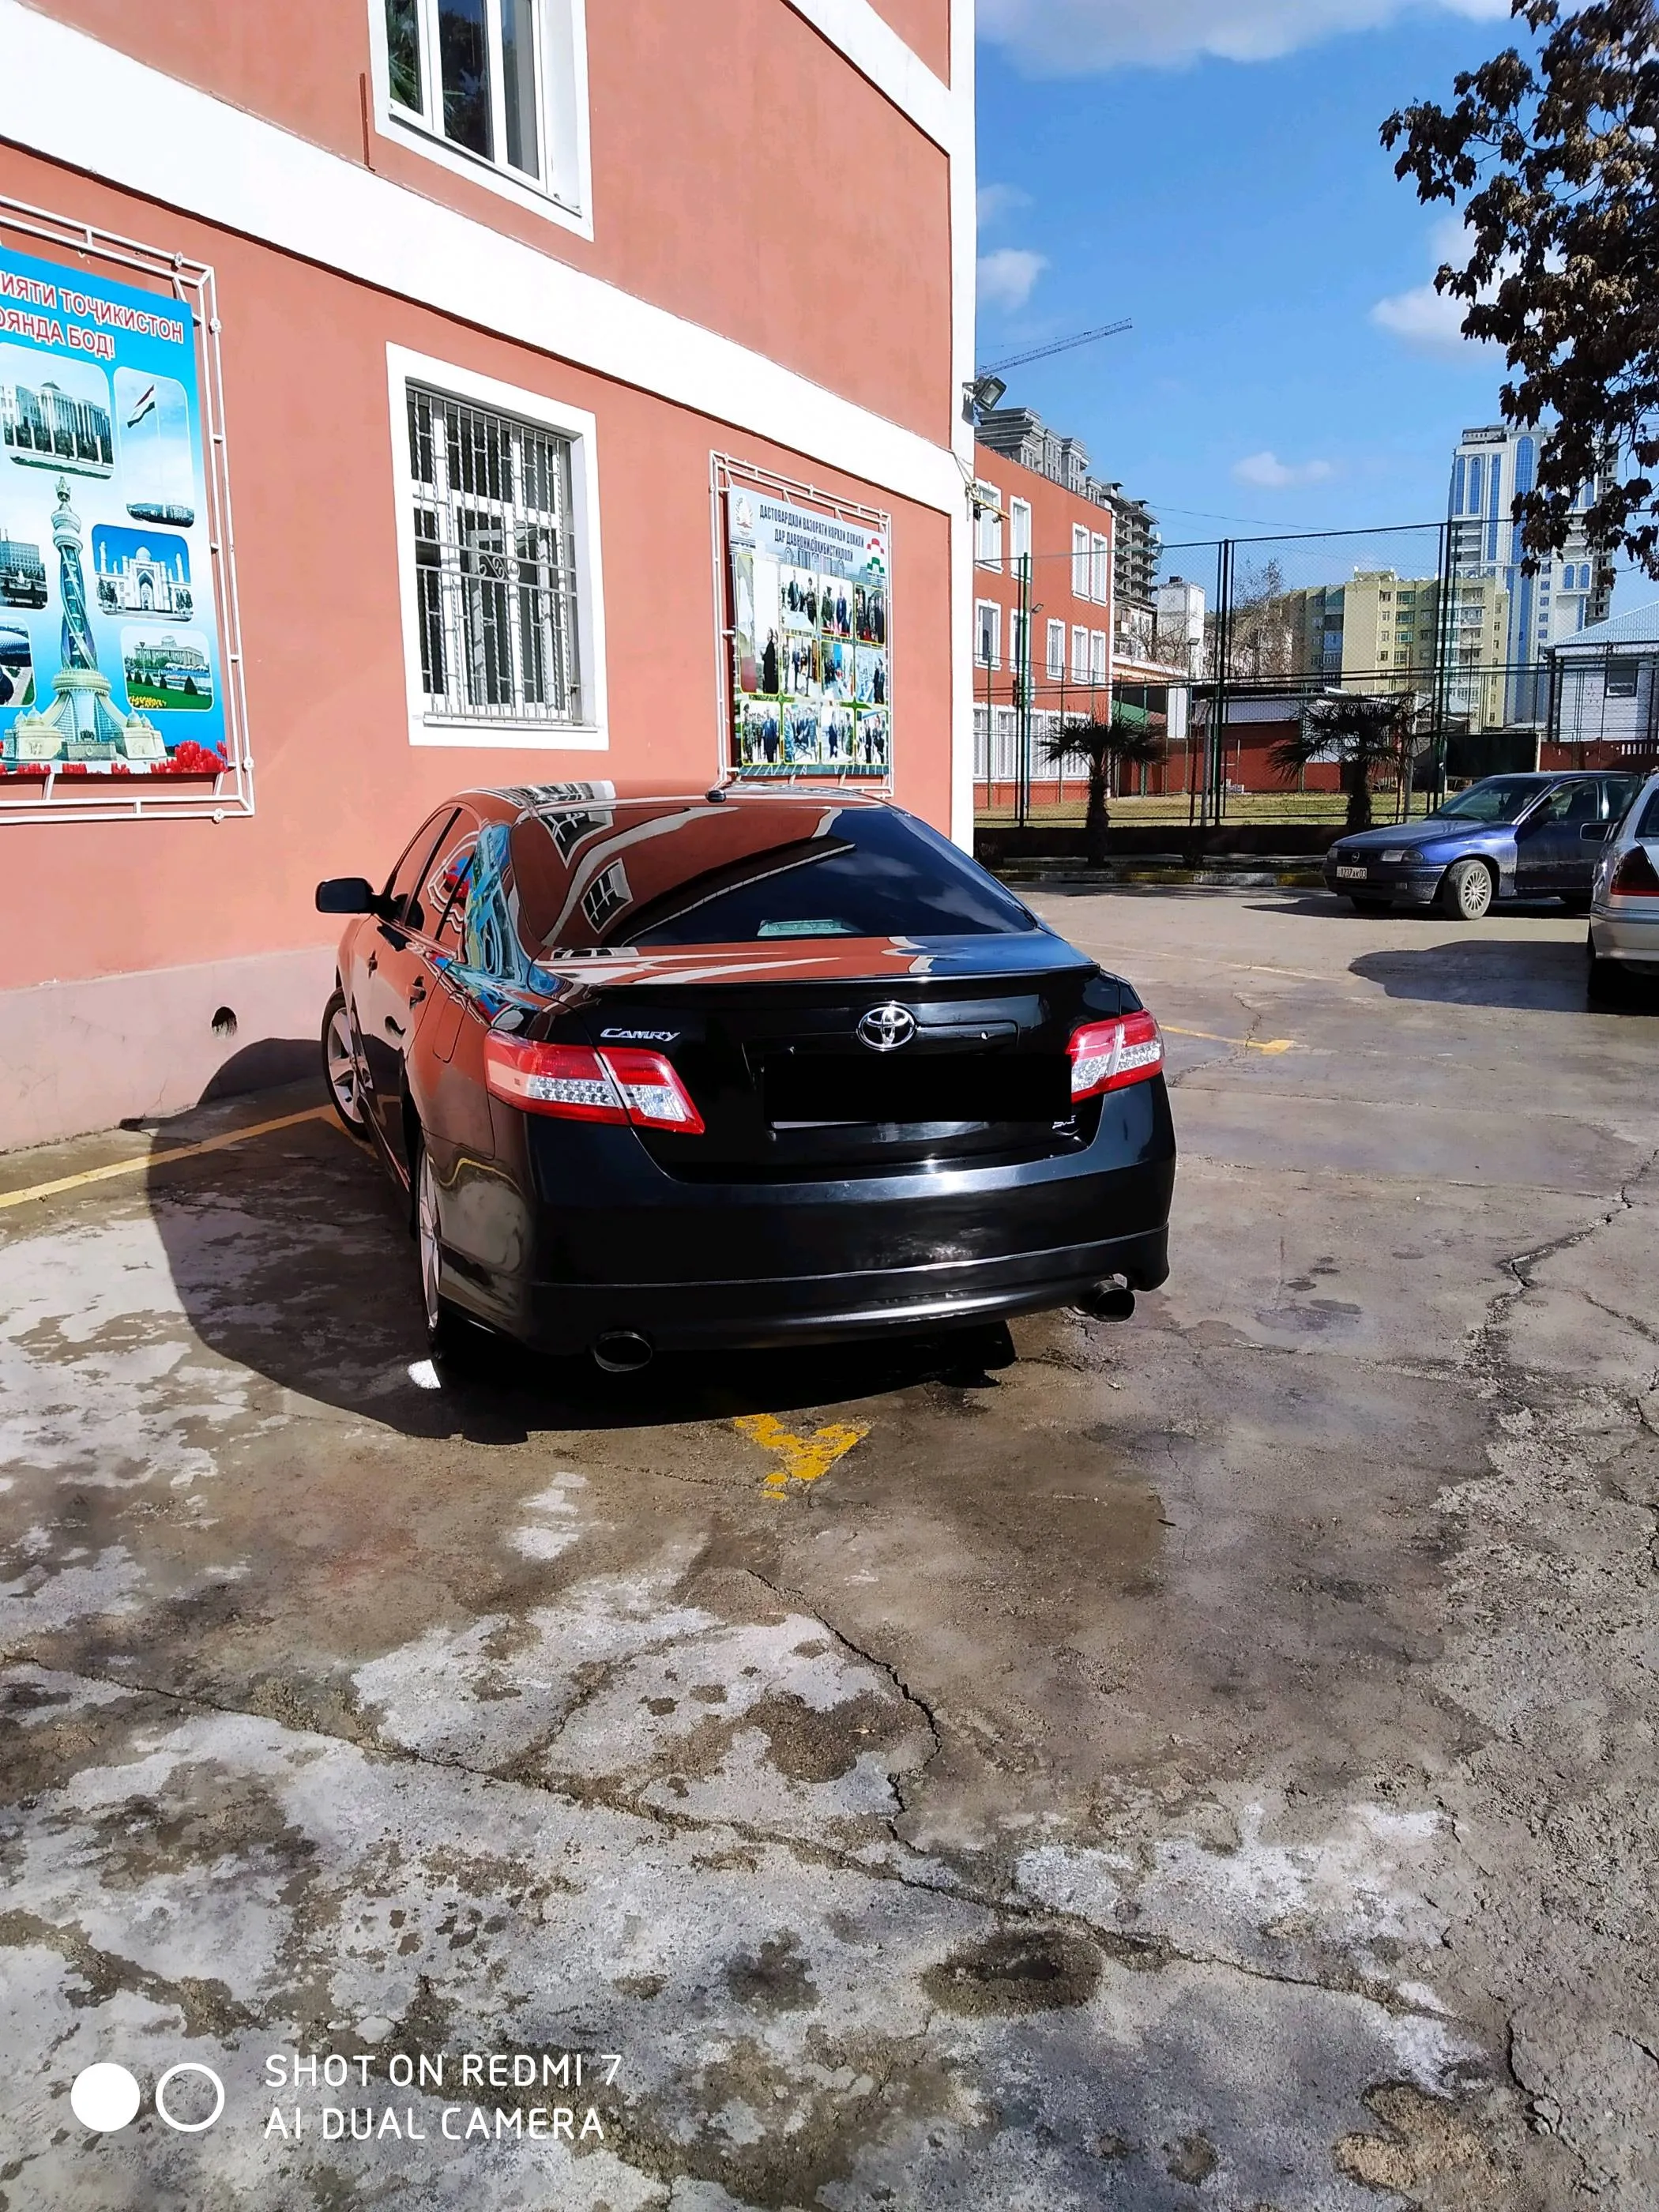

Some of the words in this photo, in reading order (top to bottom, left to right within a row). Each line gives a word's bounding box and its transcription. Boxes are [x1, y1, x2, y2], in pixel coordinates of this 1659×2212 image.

[59, 288, 183, 344] ТОҶИКИСТОН
[68, 325, 115, 359] БОД!
[600, 1028, 680, 1042] CAMRY
